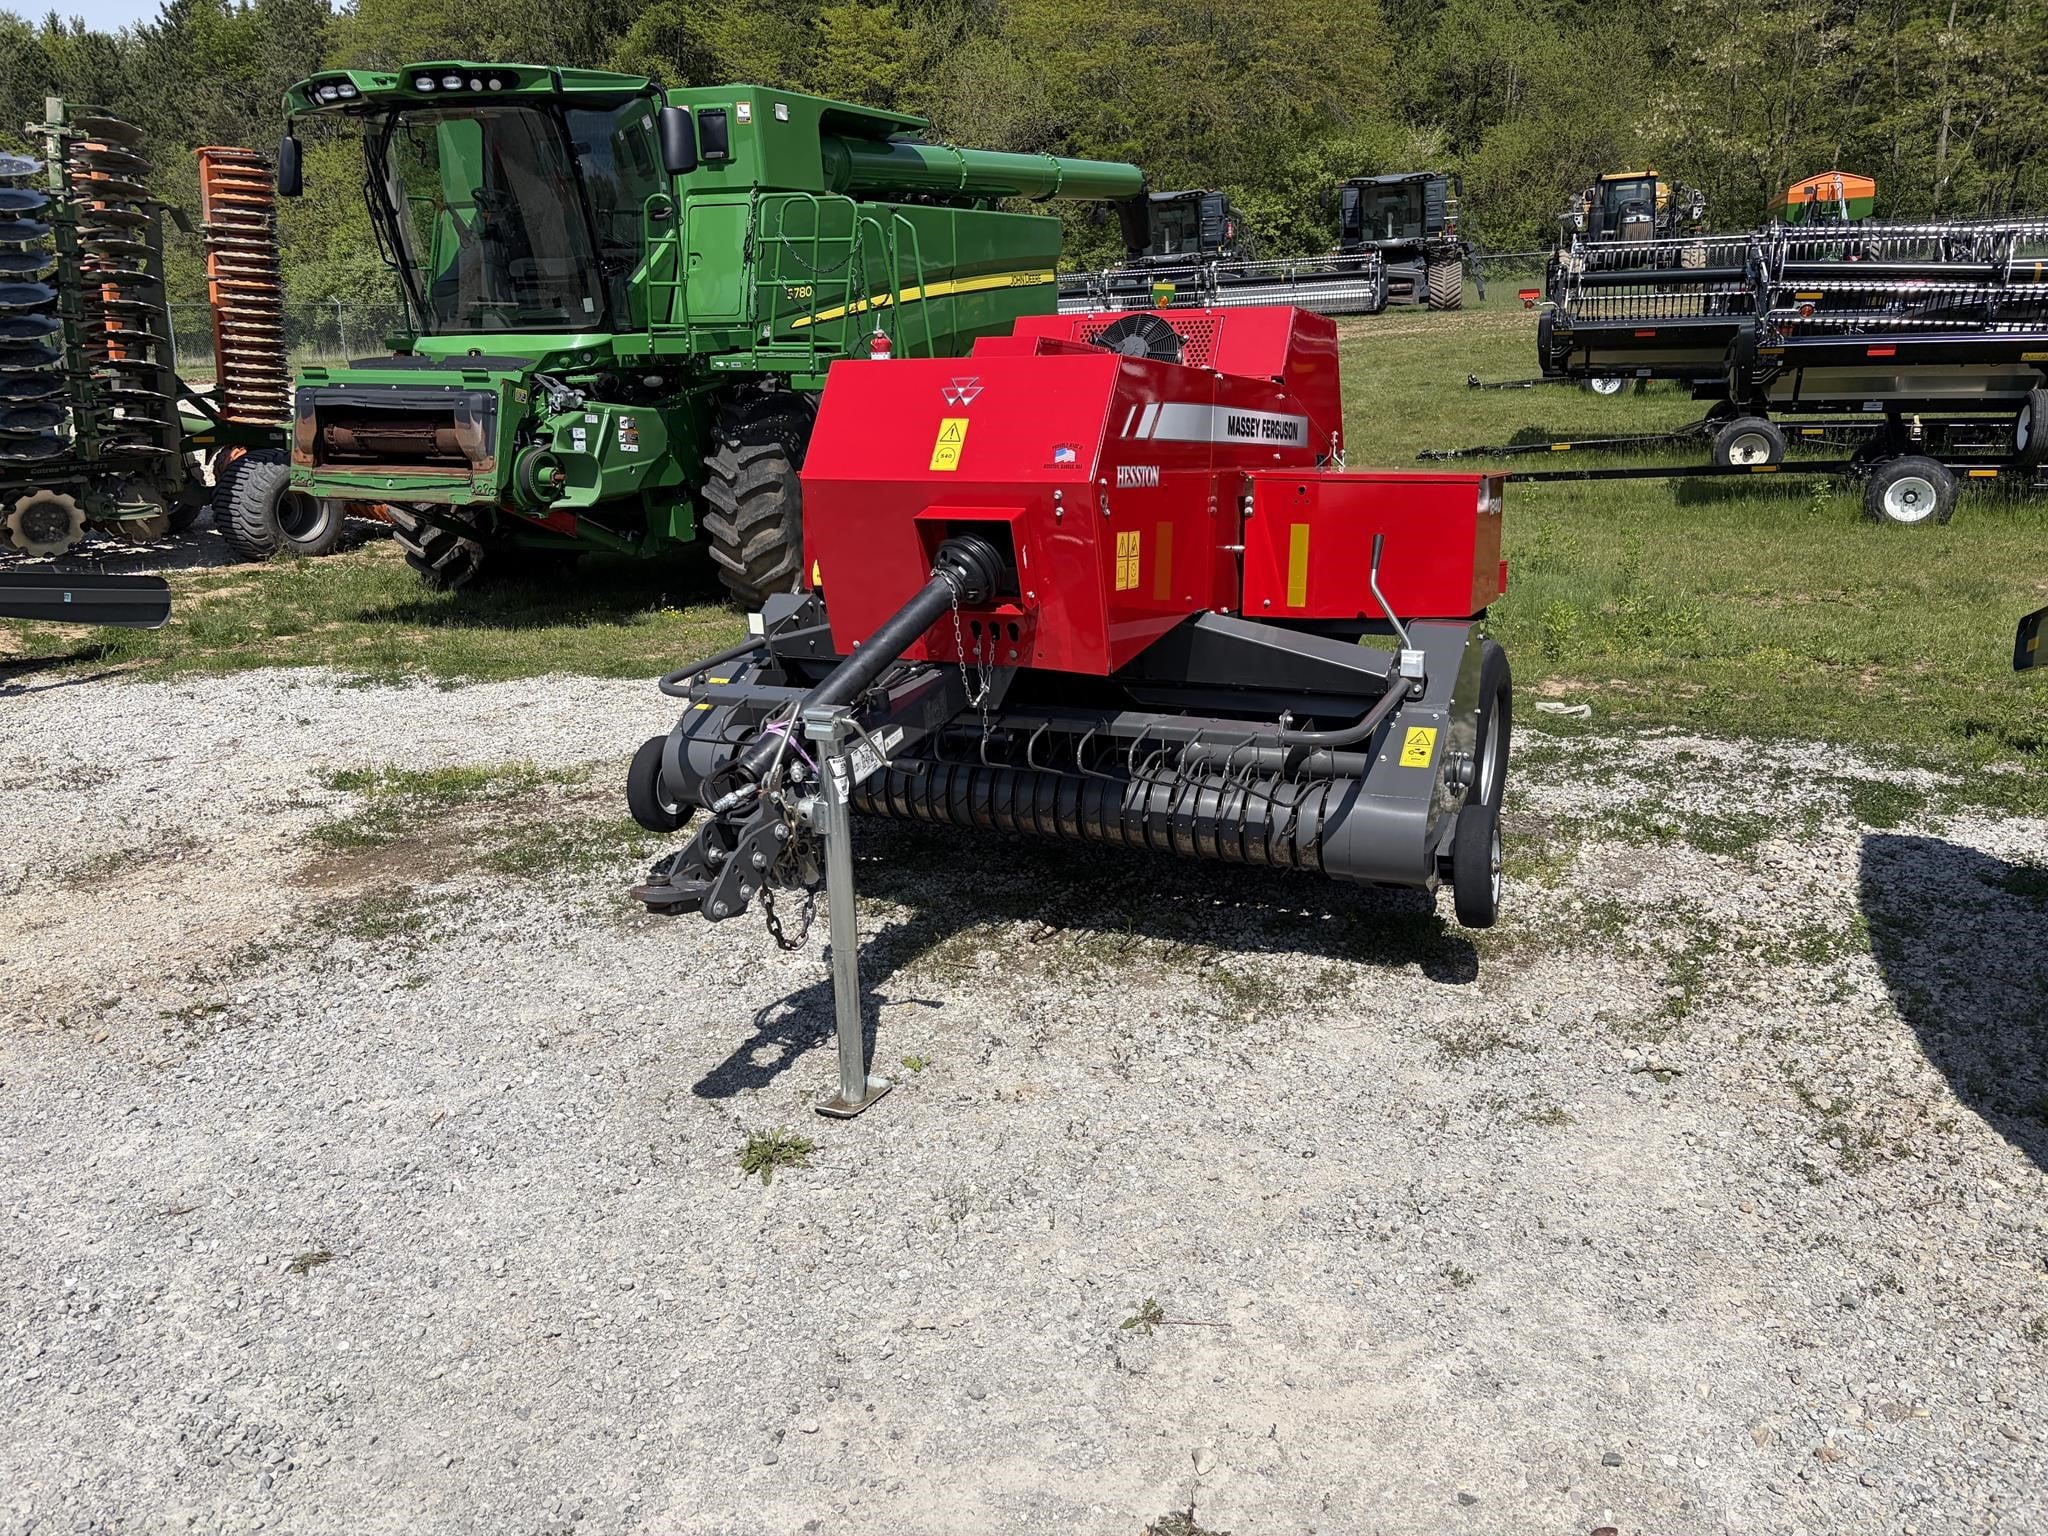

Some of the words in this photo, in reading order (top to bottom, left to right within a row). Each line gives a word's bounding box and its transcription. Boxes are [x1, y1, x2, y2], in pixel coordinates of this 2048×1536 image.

[1010, 273, 1024, 287] JOHN
[1025, 272, 1043, 285] DEERE
[787, 286, 813, 300] S780
[1228, 415, 1260, 438] MASSEY
[1262, 418, 1299, 441] FERGUSON
[1116, 465, 1160, 489] HESSTON
